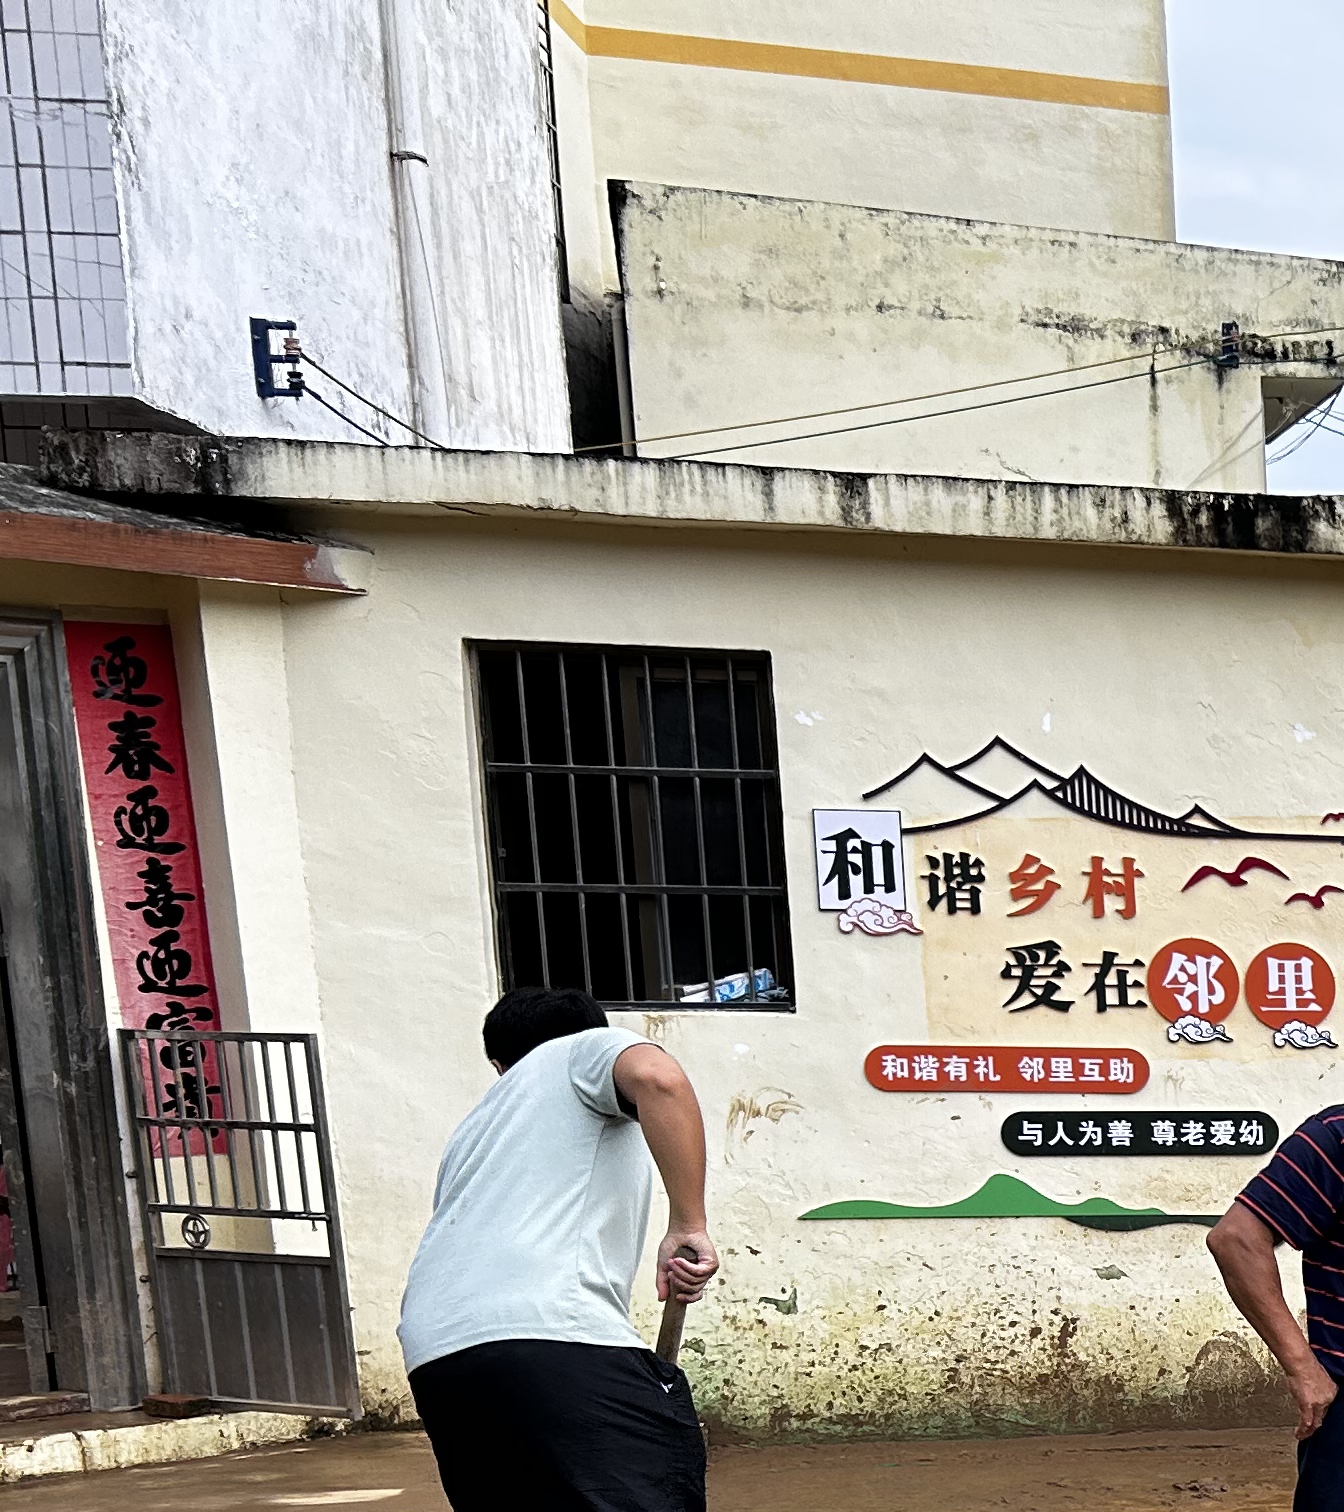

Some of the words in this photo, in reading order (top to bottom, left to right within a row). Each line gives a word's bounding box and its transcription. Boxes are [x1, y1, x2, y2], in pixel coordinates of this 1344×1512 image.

[821, 828, 1145, 919] 和谐乡村
[1000, 939, 1323, 1014] 爱在邻里
[881, 1055, 1001, 1082] 和谐有礼
[1018, 1056, 1135, 1083] 邻里互助
[1017, 1120, 1134, 1146] 与人为善
[1151, 1120, 1265, 1146] 尊老爱幼
